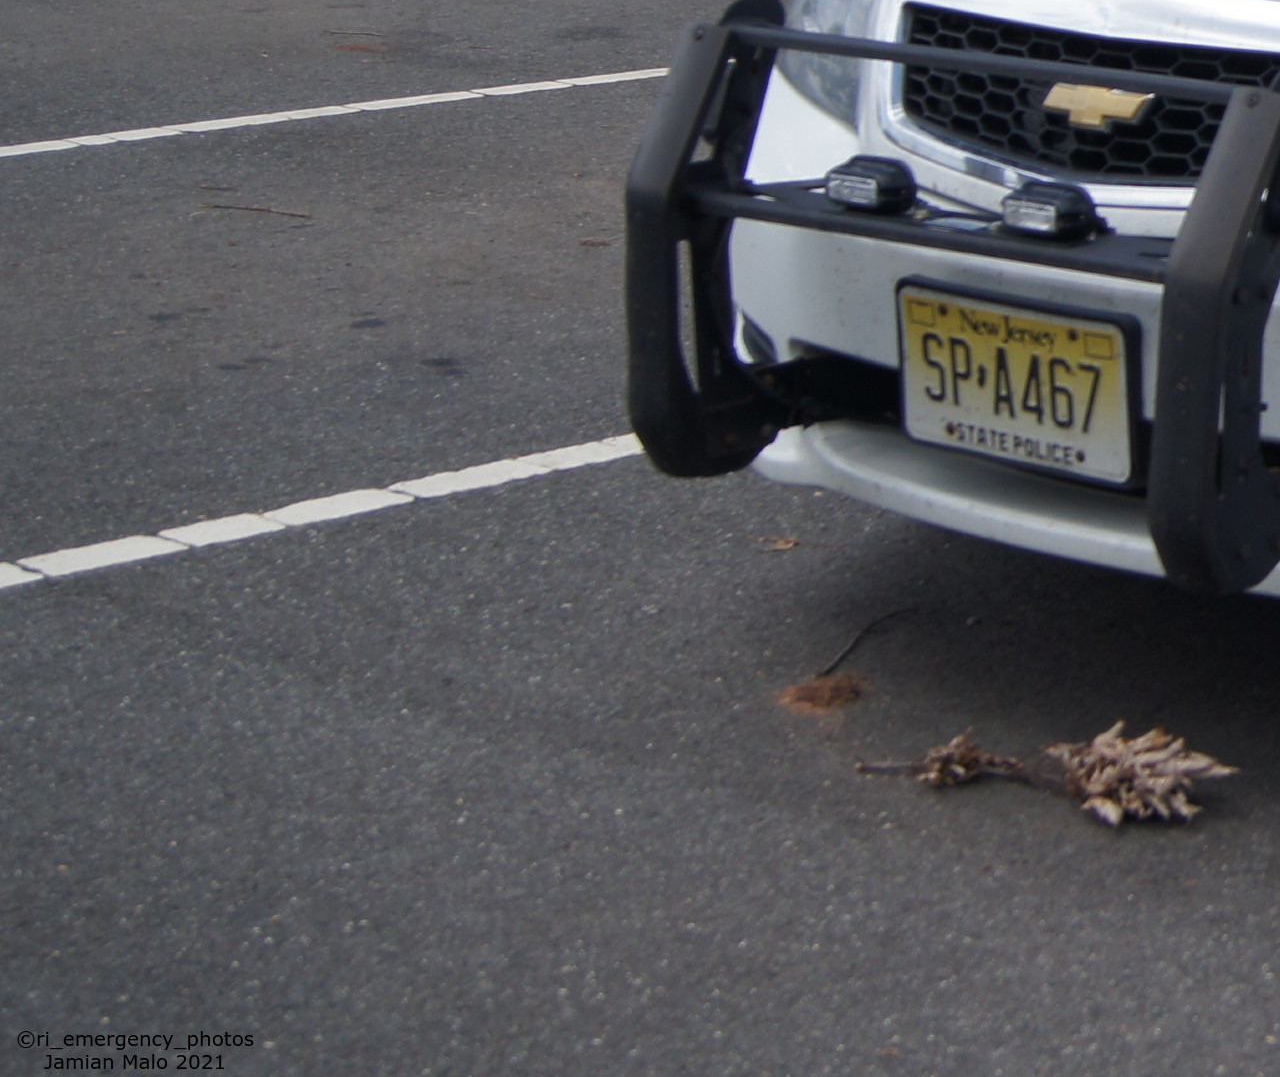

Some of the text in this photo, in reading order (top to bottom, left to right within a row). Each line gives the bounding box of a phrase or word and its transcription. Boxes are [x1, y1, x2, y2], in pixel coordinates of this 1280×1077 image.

[958, 307, 1056, 354] New Jersey
[955, 423, 1075, 465] STATE POLICE
